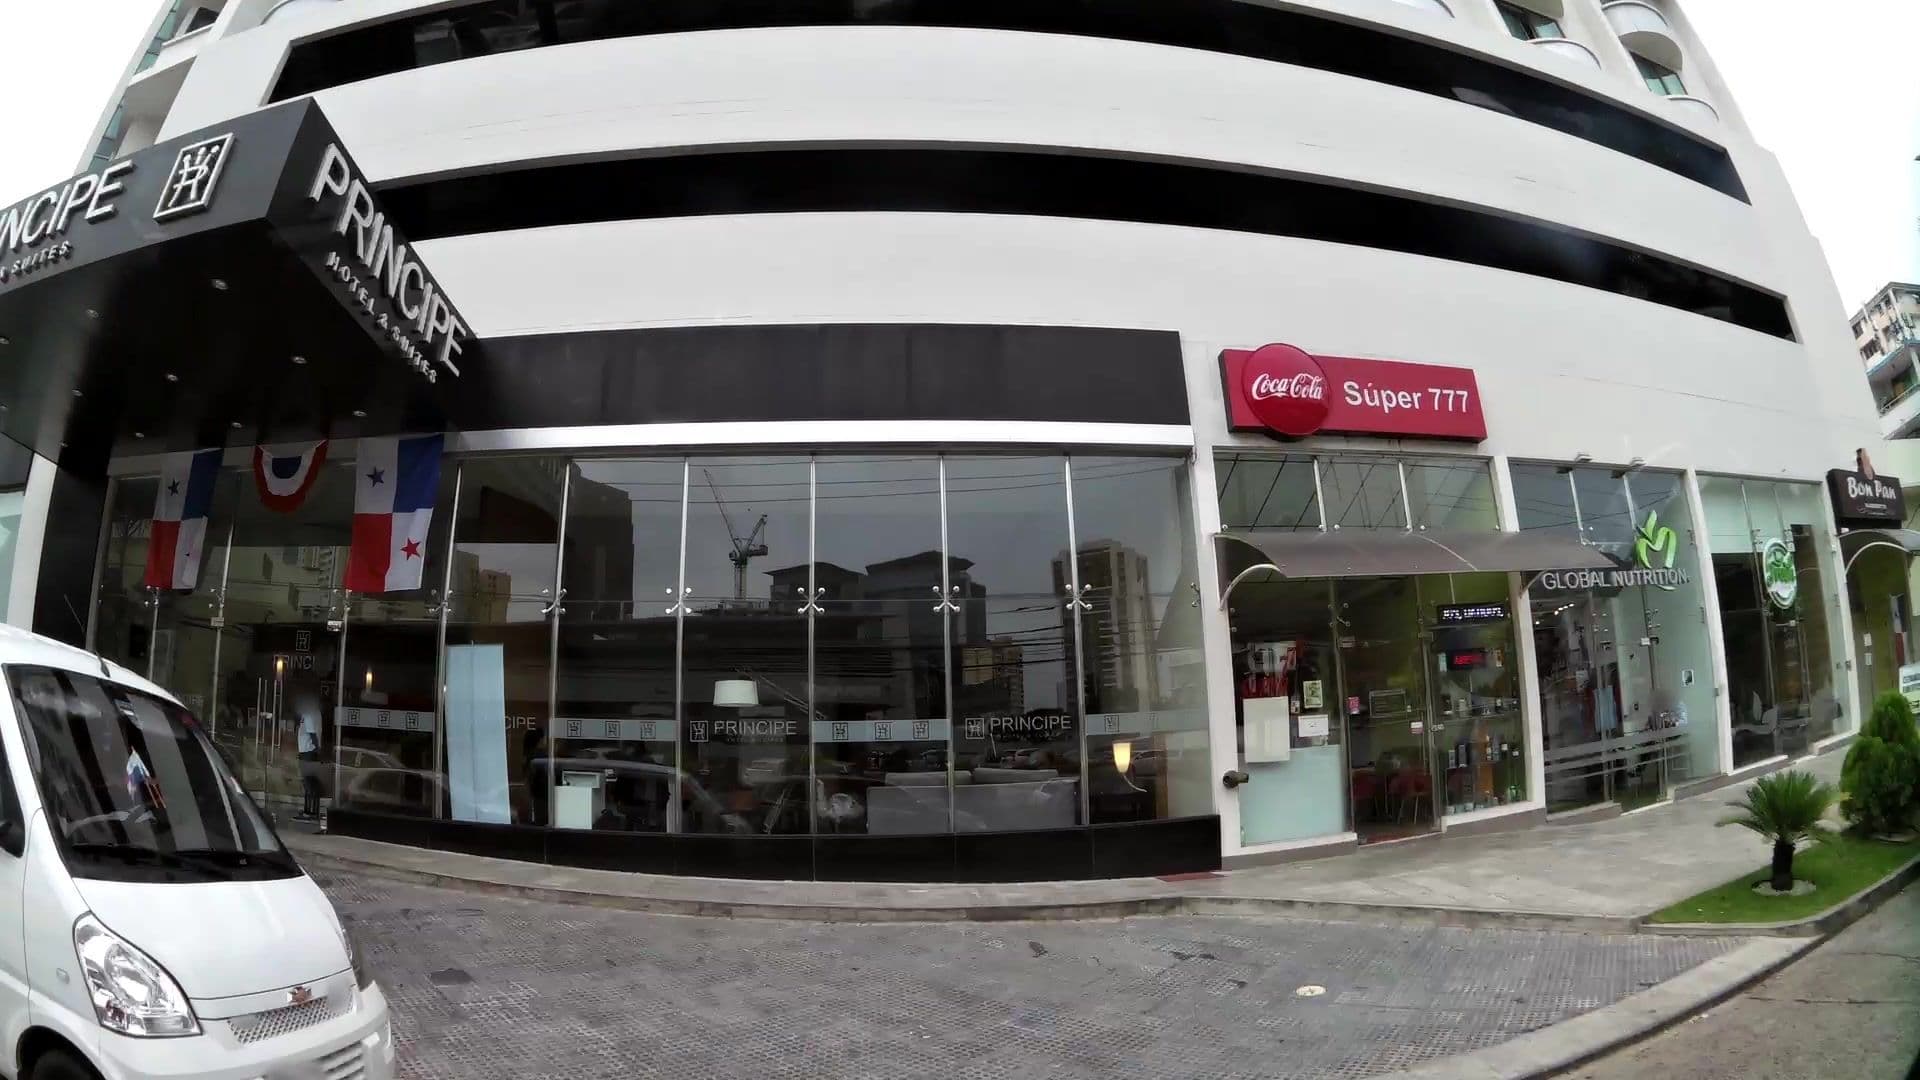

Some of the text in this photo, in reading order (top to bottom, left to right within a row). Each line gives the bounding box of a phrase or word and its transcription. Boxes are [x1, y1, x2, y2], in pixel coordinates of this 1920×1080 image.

[11, 240, 72, 276] SUITES
[309, 142, 467, 377] PRINCIPE
[325, 251, 375, 315] HOTEL
[390, 325, 437, 384] SUITES
[1252, 373, 1323, 401] Coca-Cola
[1343, 381, 1469, 413] Súper 777
[1542, 568, 1688, 590] GLOBAL NUTRITION
[714, 720, 797, 735] PRINCIPE
[990, 715, 1072, 732] PRINCIPE
